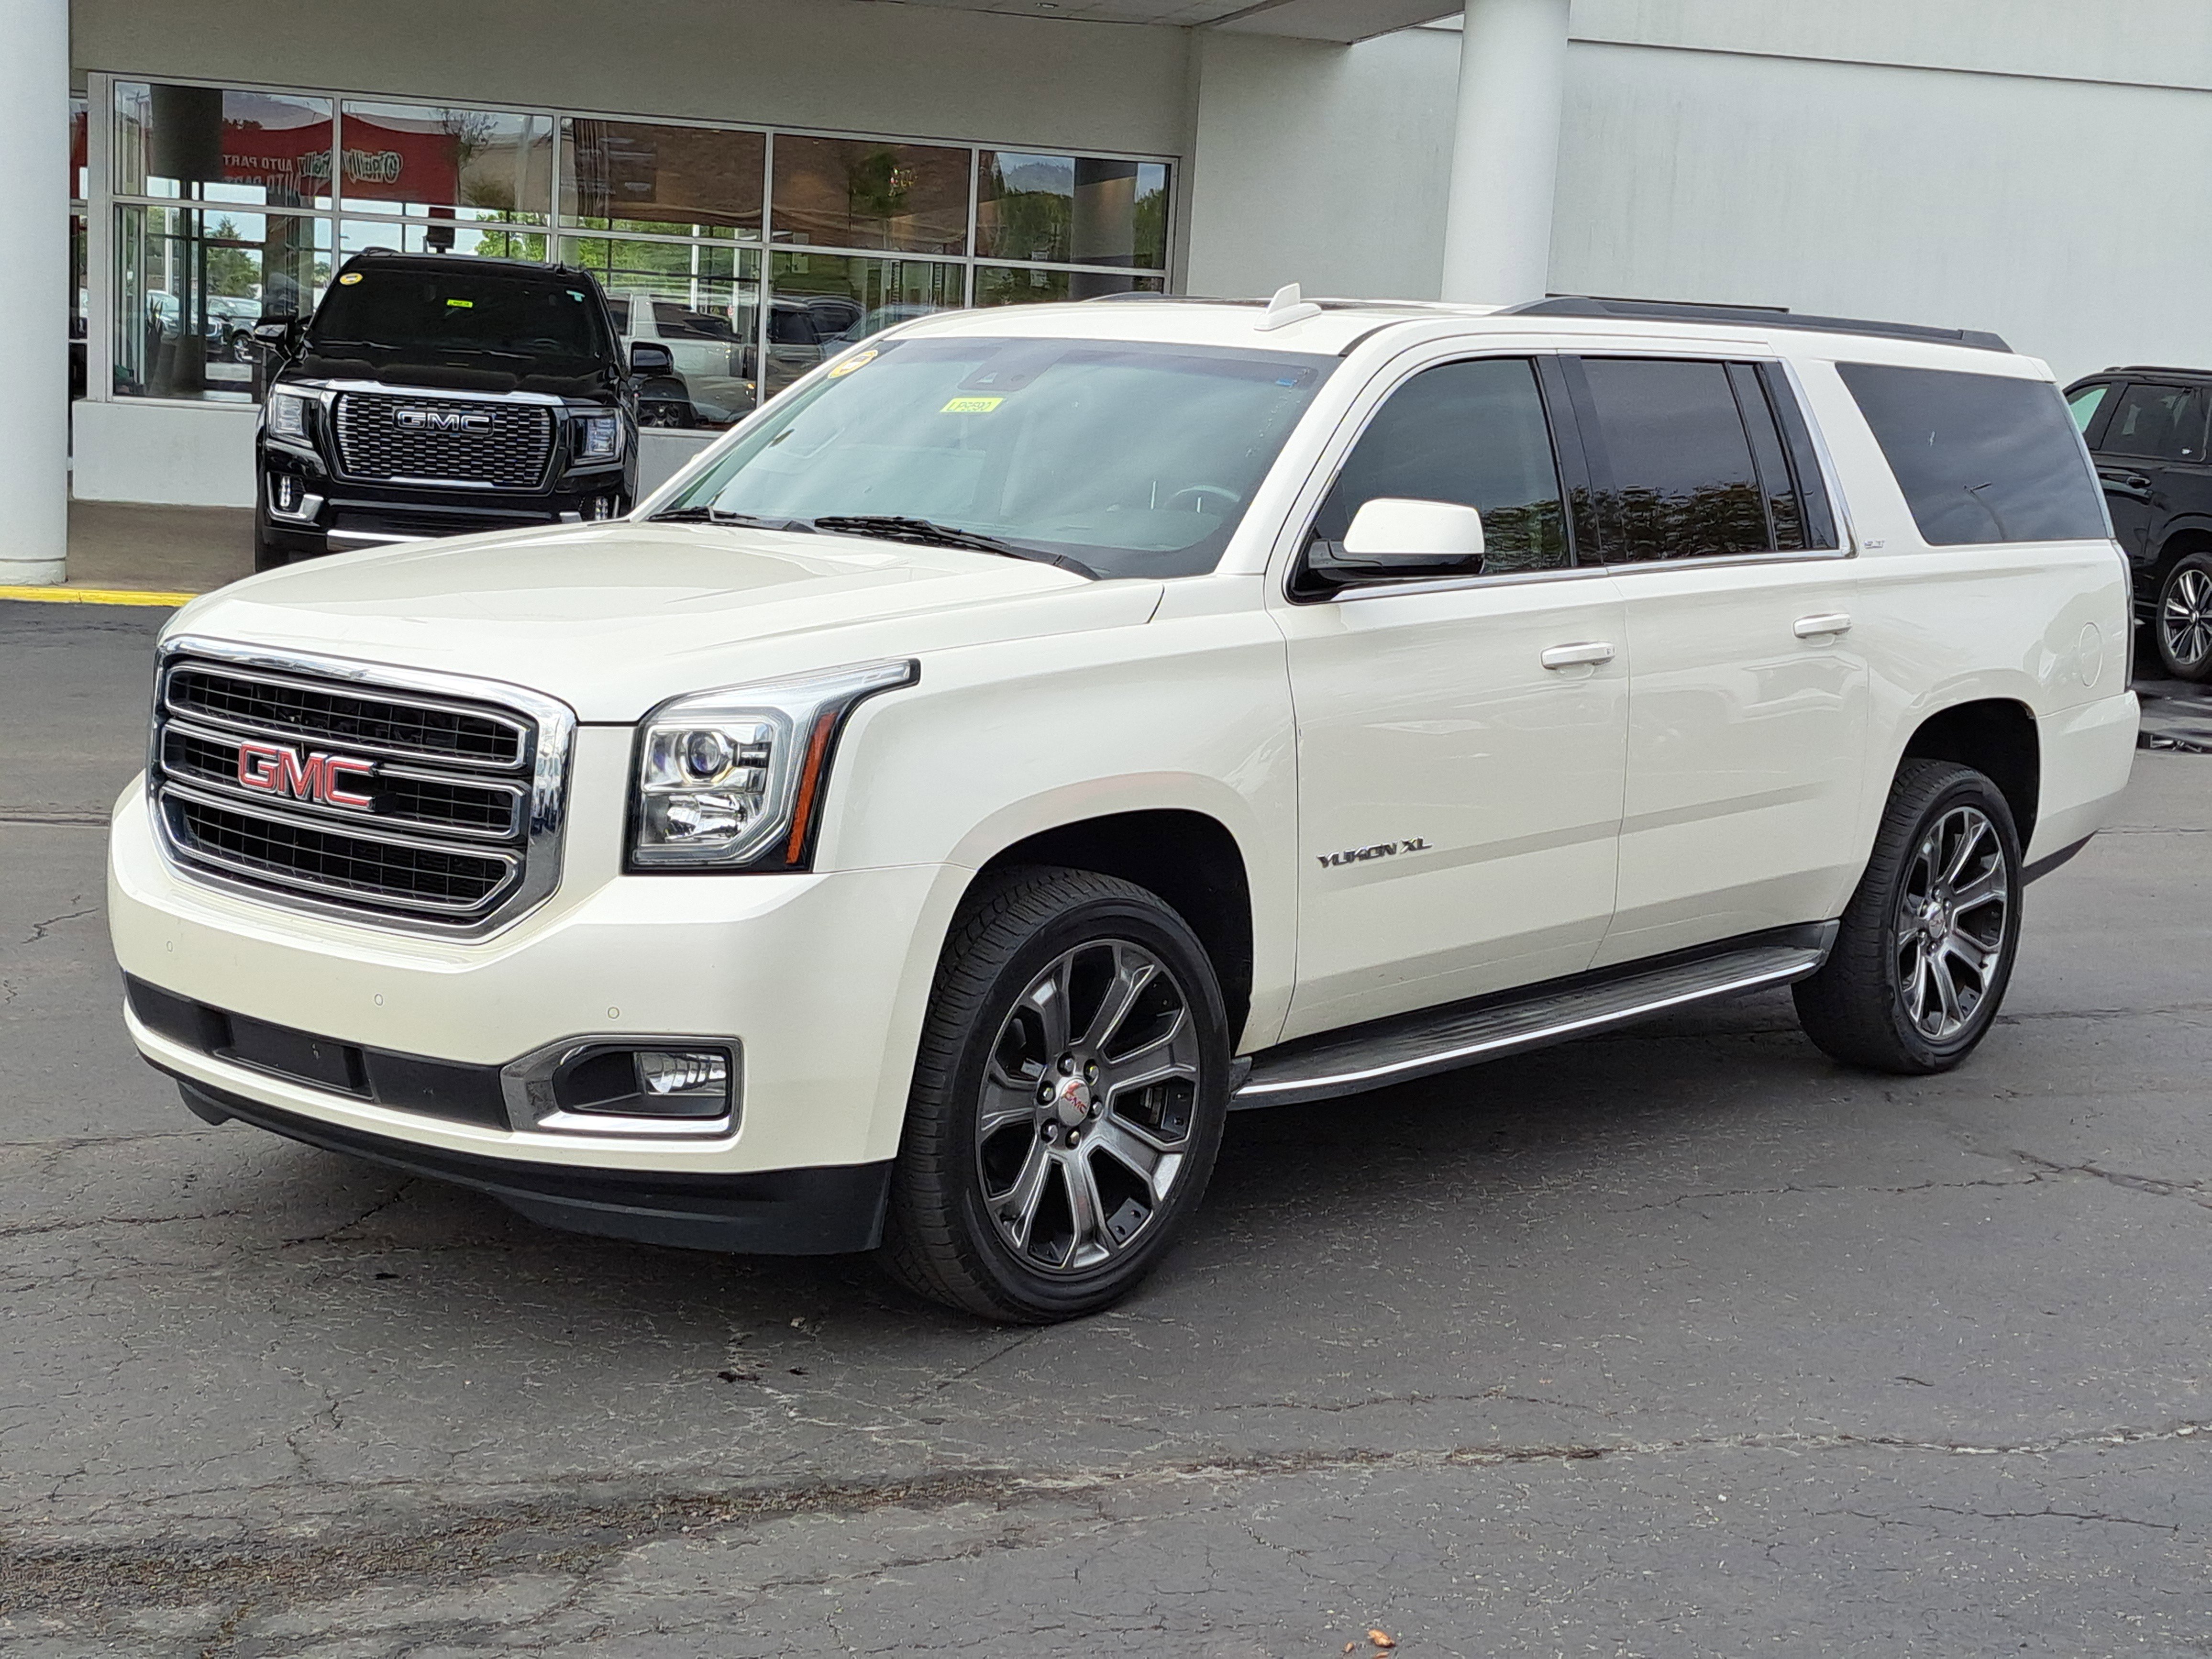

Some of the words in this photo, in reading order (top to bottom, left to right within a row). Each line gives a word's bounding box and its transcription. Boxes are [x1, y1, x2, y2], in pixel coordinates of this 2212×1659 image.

[398, 411, 490, 434] GMC
[238, 740, 377, 812] GMC
[1316, 840, 1398, 869] YUKON
[1399, 836, 1434, 855] XL
[1061, 1090, 1087, 1114] GMC
